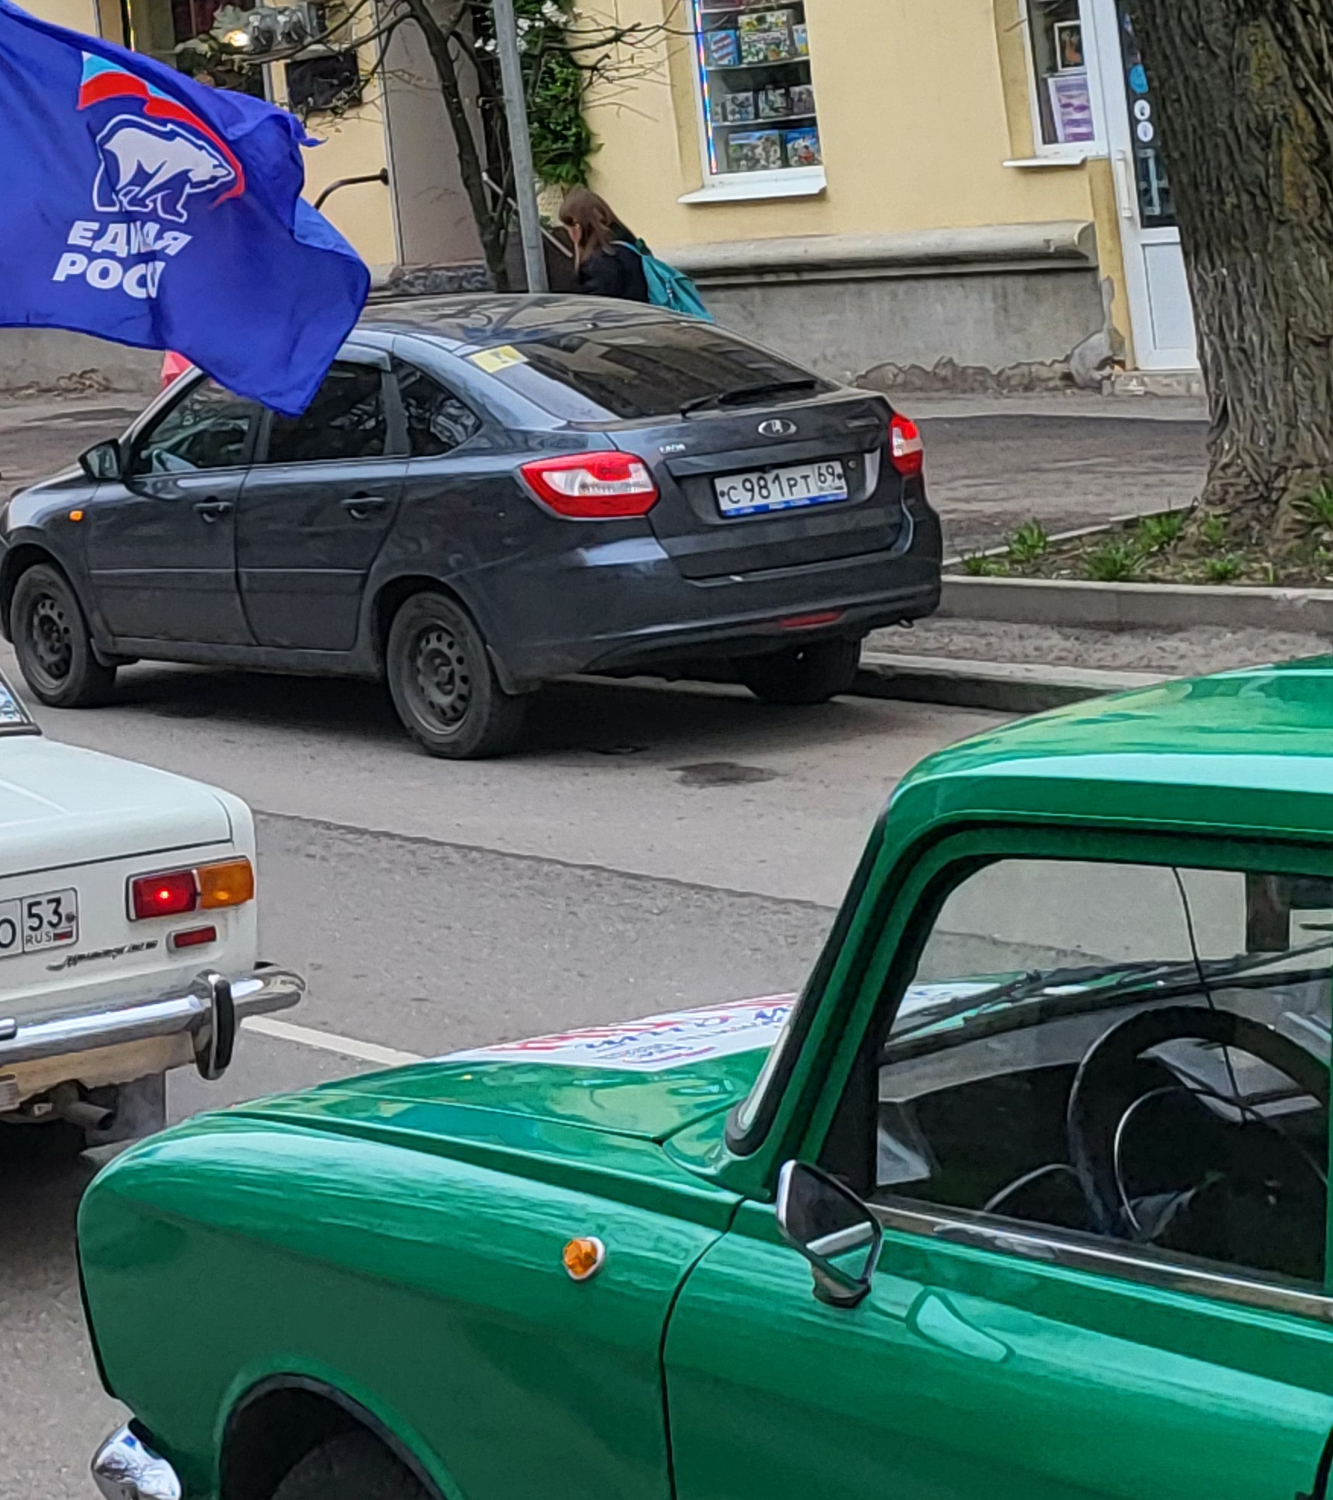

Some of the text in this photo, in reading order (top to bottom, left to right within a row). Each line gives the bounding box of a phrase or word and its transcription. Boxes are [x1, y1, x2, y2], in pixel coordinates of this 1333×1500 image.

[726, 465, 836, 504] С981РТ 69
[26, 896, 63, 932] 53
[25, 931, 52, 945] RUS
